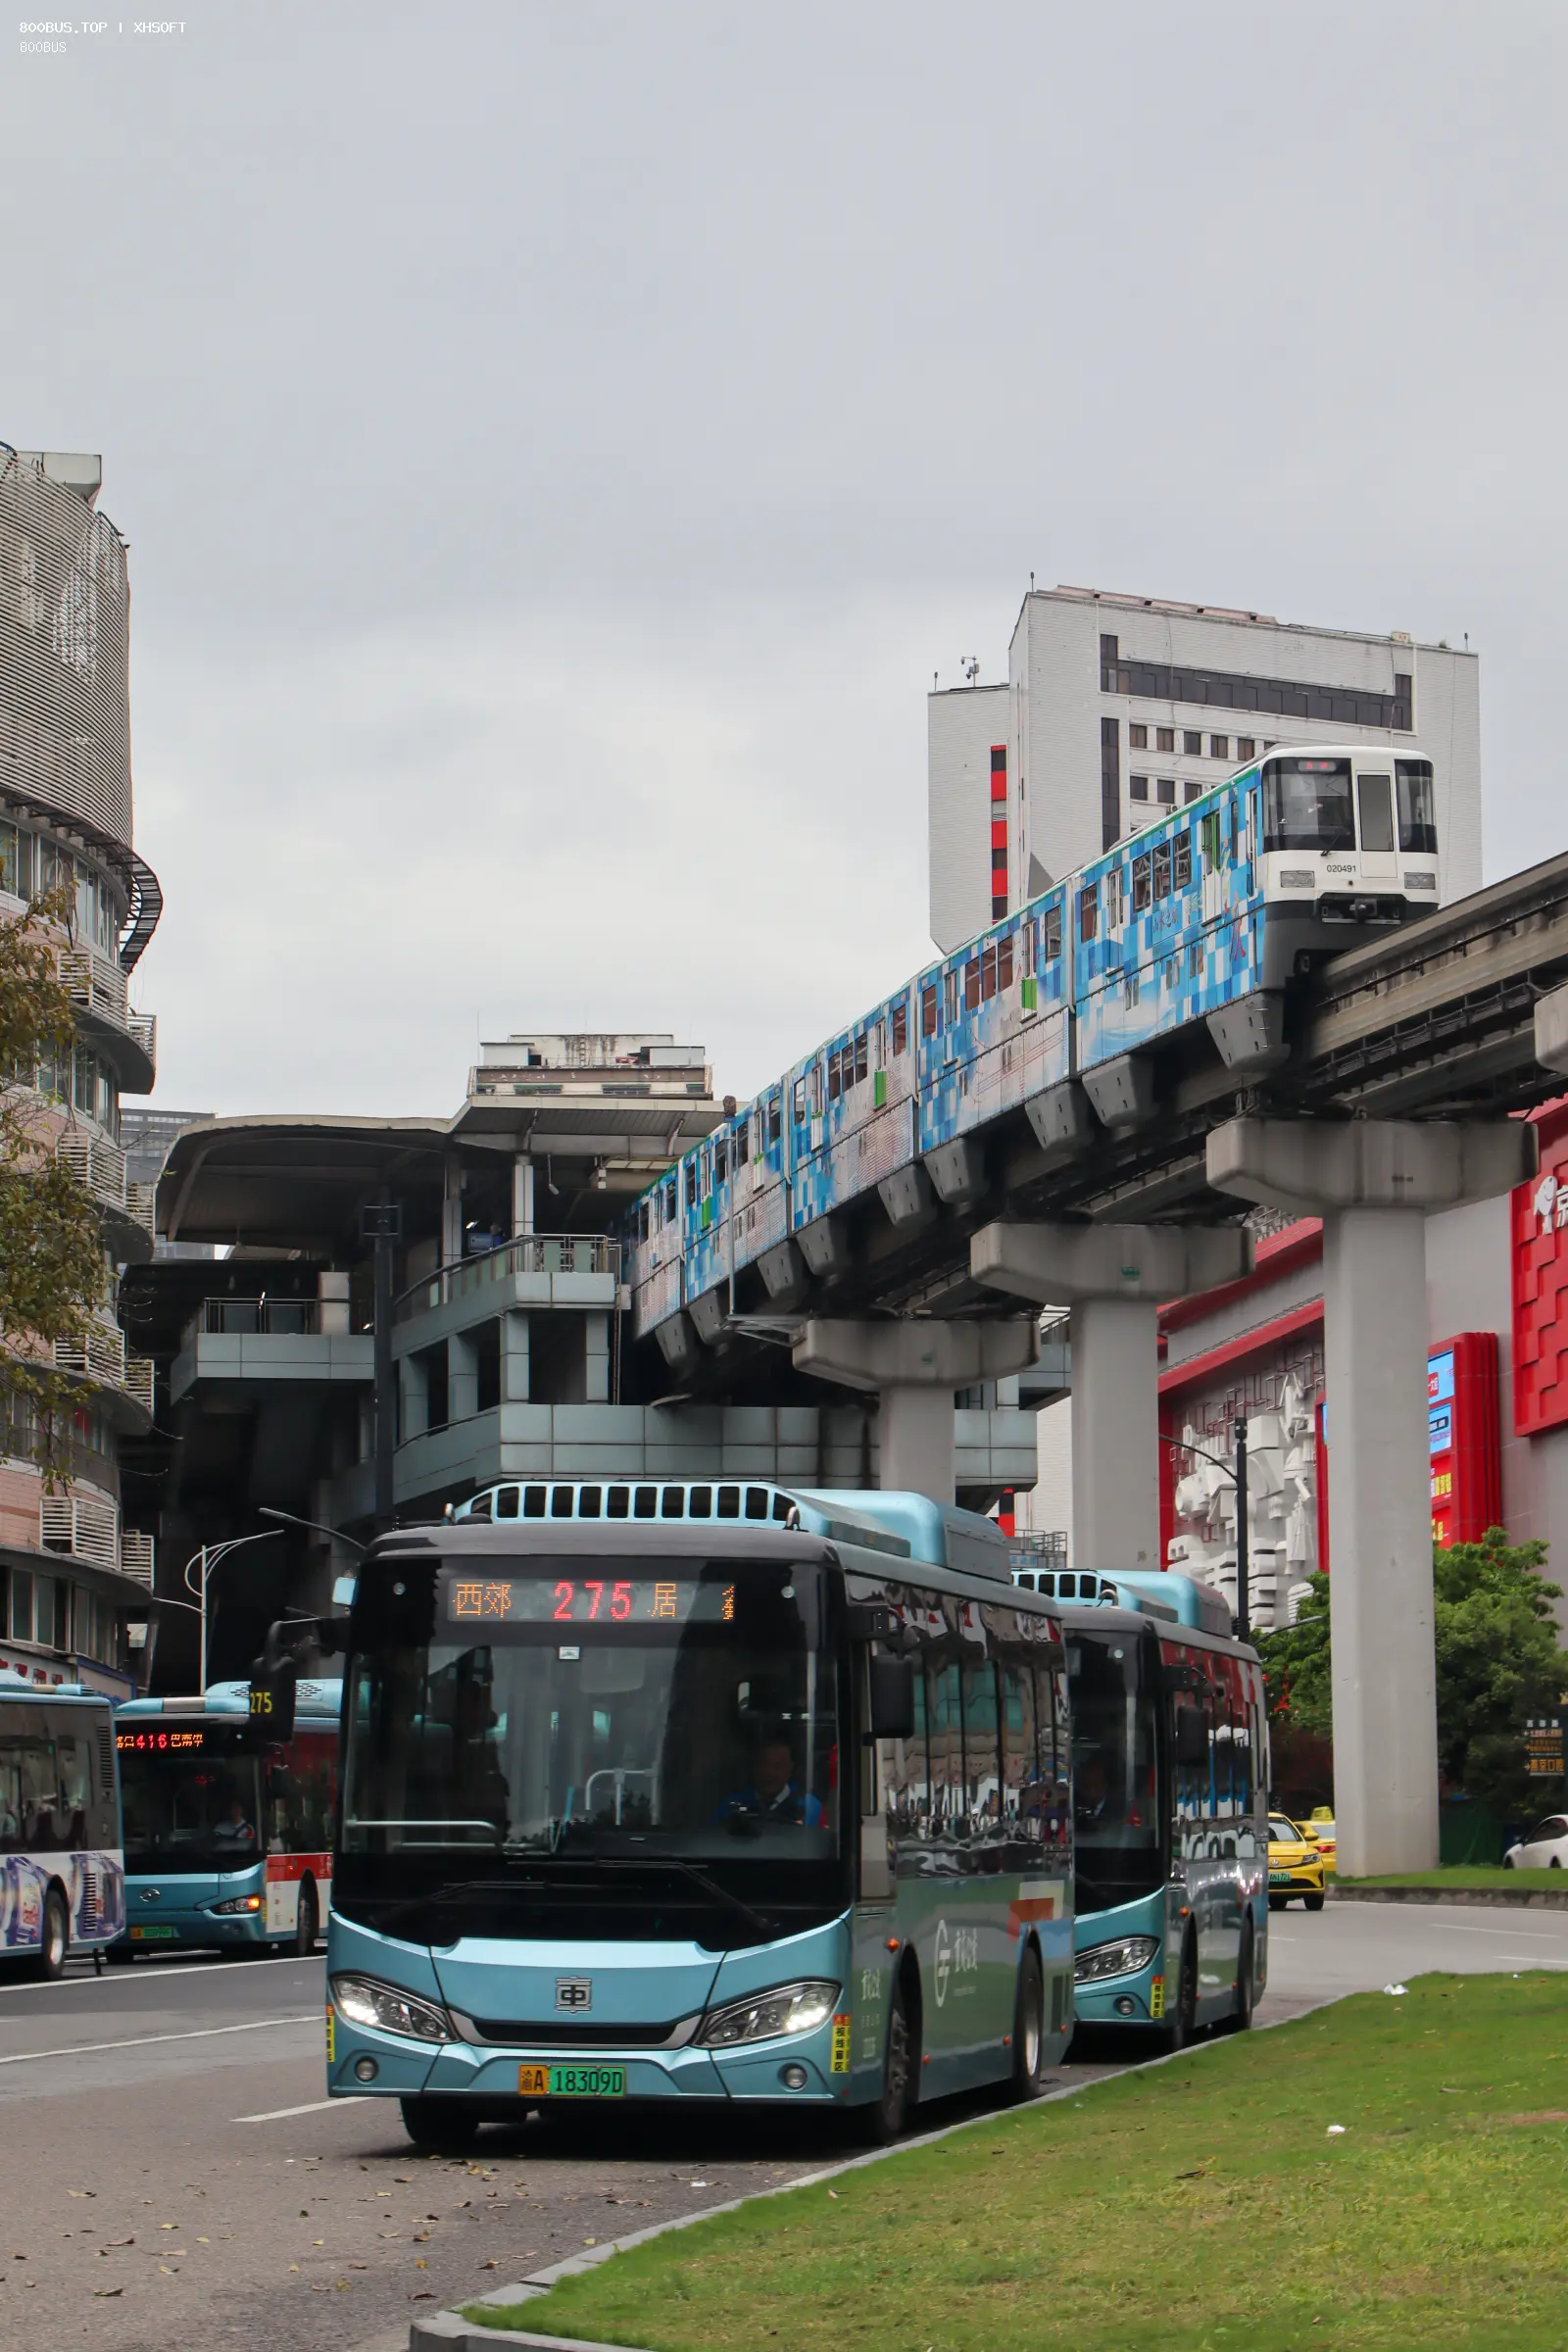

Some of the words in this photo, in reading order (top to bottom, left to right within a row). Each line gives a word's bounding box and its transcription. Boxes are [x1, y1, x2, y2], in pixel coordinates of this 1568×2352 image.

[1326, 864, 1356, 873] 020491
[454, 1582, 513, 1618] 西郊
[553, 1582, 632, 1619] 275
[249, 1691, 272, 1713] 275
[137, 1733, 168, 1749] 416
[555, 2070, 623, 2093] 18309D
